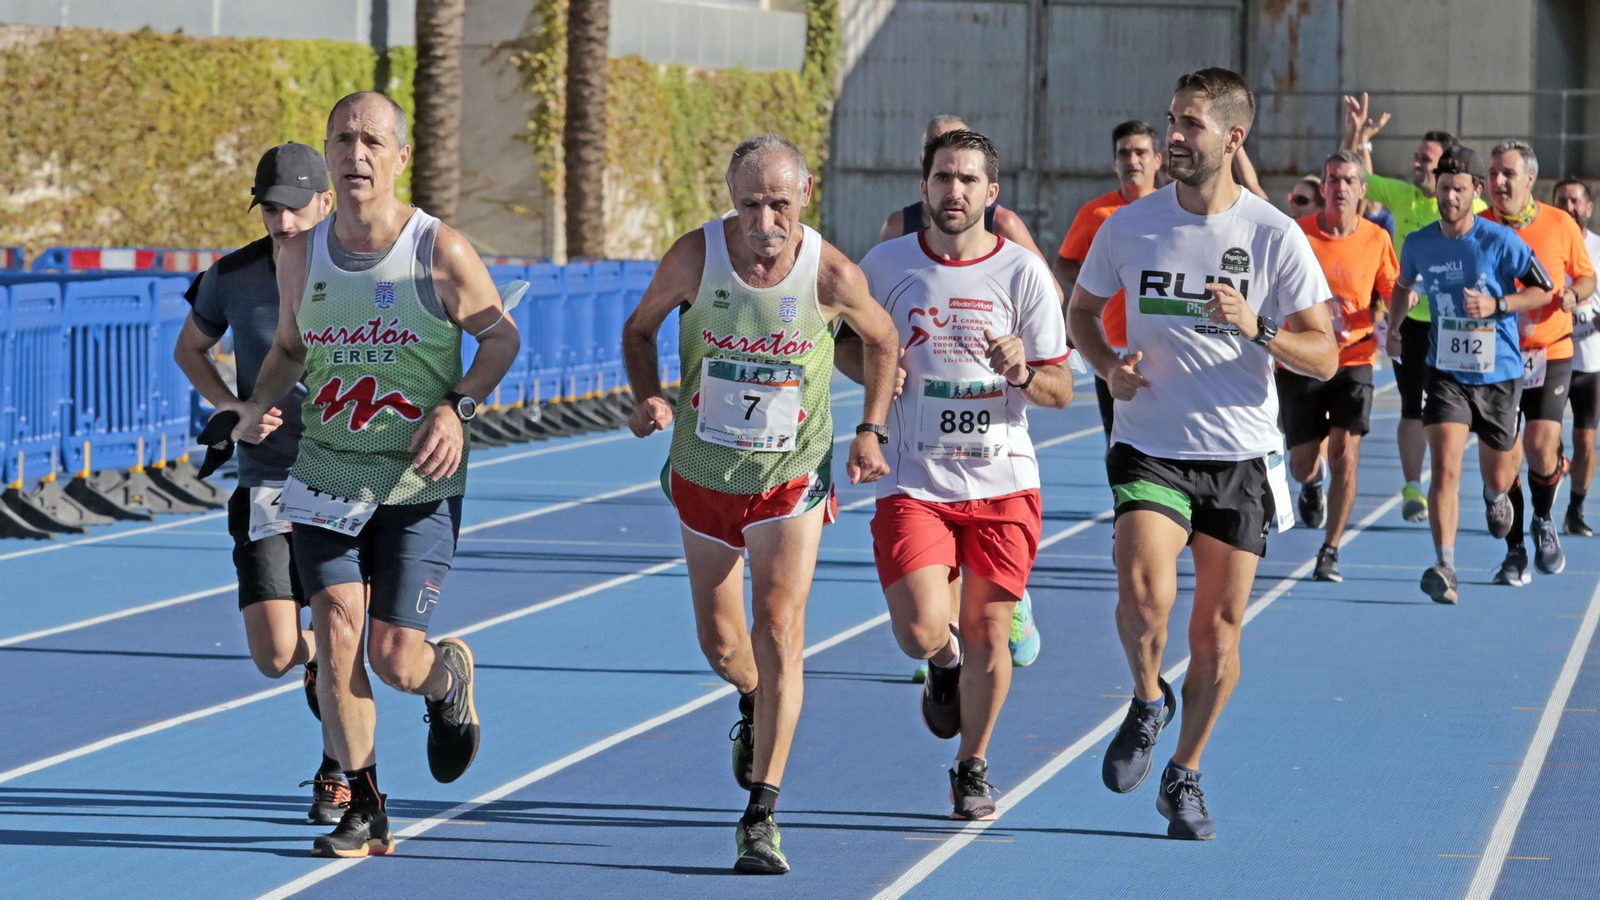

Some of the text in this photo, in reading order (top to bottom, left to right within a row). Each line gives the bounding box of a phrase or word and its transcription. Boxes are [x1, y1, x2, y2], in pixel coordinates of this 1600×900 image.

[1446, 261, 1462, 271] XLI
[1140, 270, 1249, 300] RUN
[303, 316, 421, 346] maratón
[952, 315, 993, 326] I CARRERA
[701, 329, 815, 356] maratón
[1451, 338, 1482, 355] 812
[326, 349, 396, 365] EREZ
[743, 395, 761, 421] 7
[940, 410, 991, 434] 889
